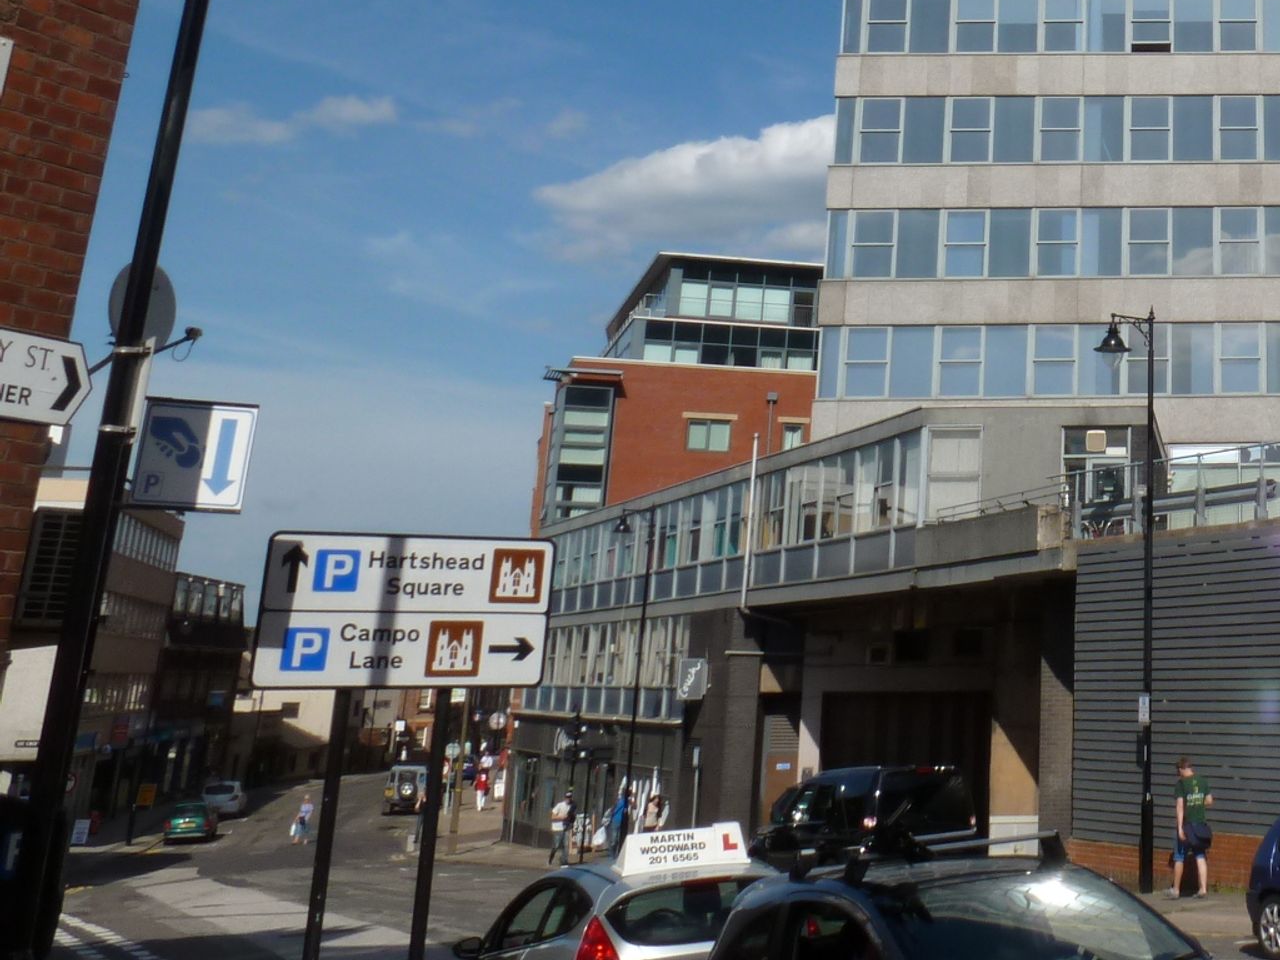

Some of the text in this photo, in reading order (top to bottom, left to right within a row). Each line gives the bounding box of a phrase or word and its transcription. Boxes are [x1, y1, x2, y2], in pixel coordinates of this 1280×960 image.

[145, 474, 159, 494] P
[323, 550, 485, 589] P Hartshead
[386, 577, 465, 599] Square
[290, 623, 420, 668] P Campo
[349, 651, 404, 669] Lane
[650, 832, 694, 844] MARTIN
[722, 833, 738, 851] L
[640, 842, 706, 855] WOODWARD
[648, 852, 699, 865] 201 6565
